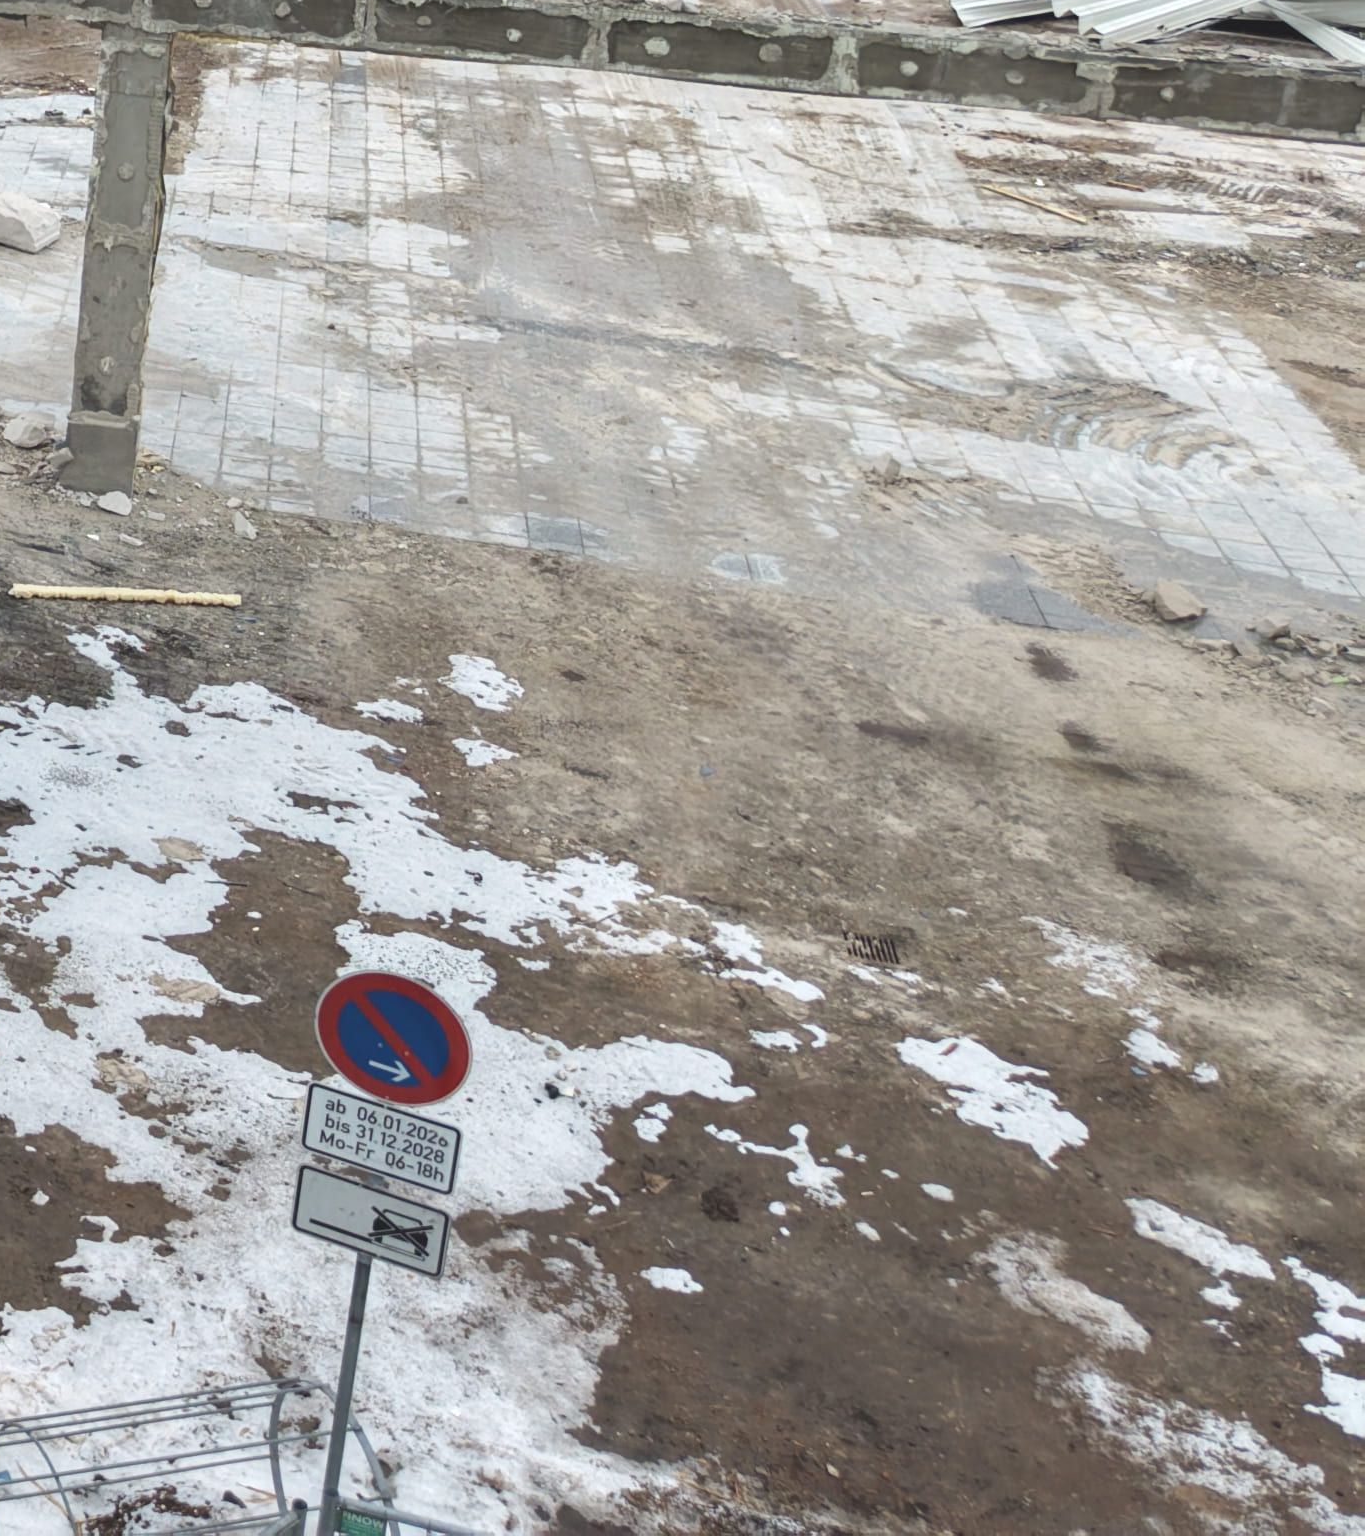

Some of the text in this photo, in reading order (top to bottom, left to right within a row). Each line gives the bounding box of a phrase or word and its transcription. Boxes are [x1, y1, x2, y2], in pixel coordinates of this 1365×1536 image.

[325, 1099, 448, 1147] ab 06.01.2026
[325, 1114, 445, 1164] bis 31.12.2028
[319, 1130, 444, 1183] Mo-Fr 06-18h
